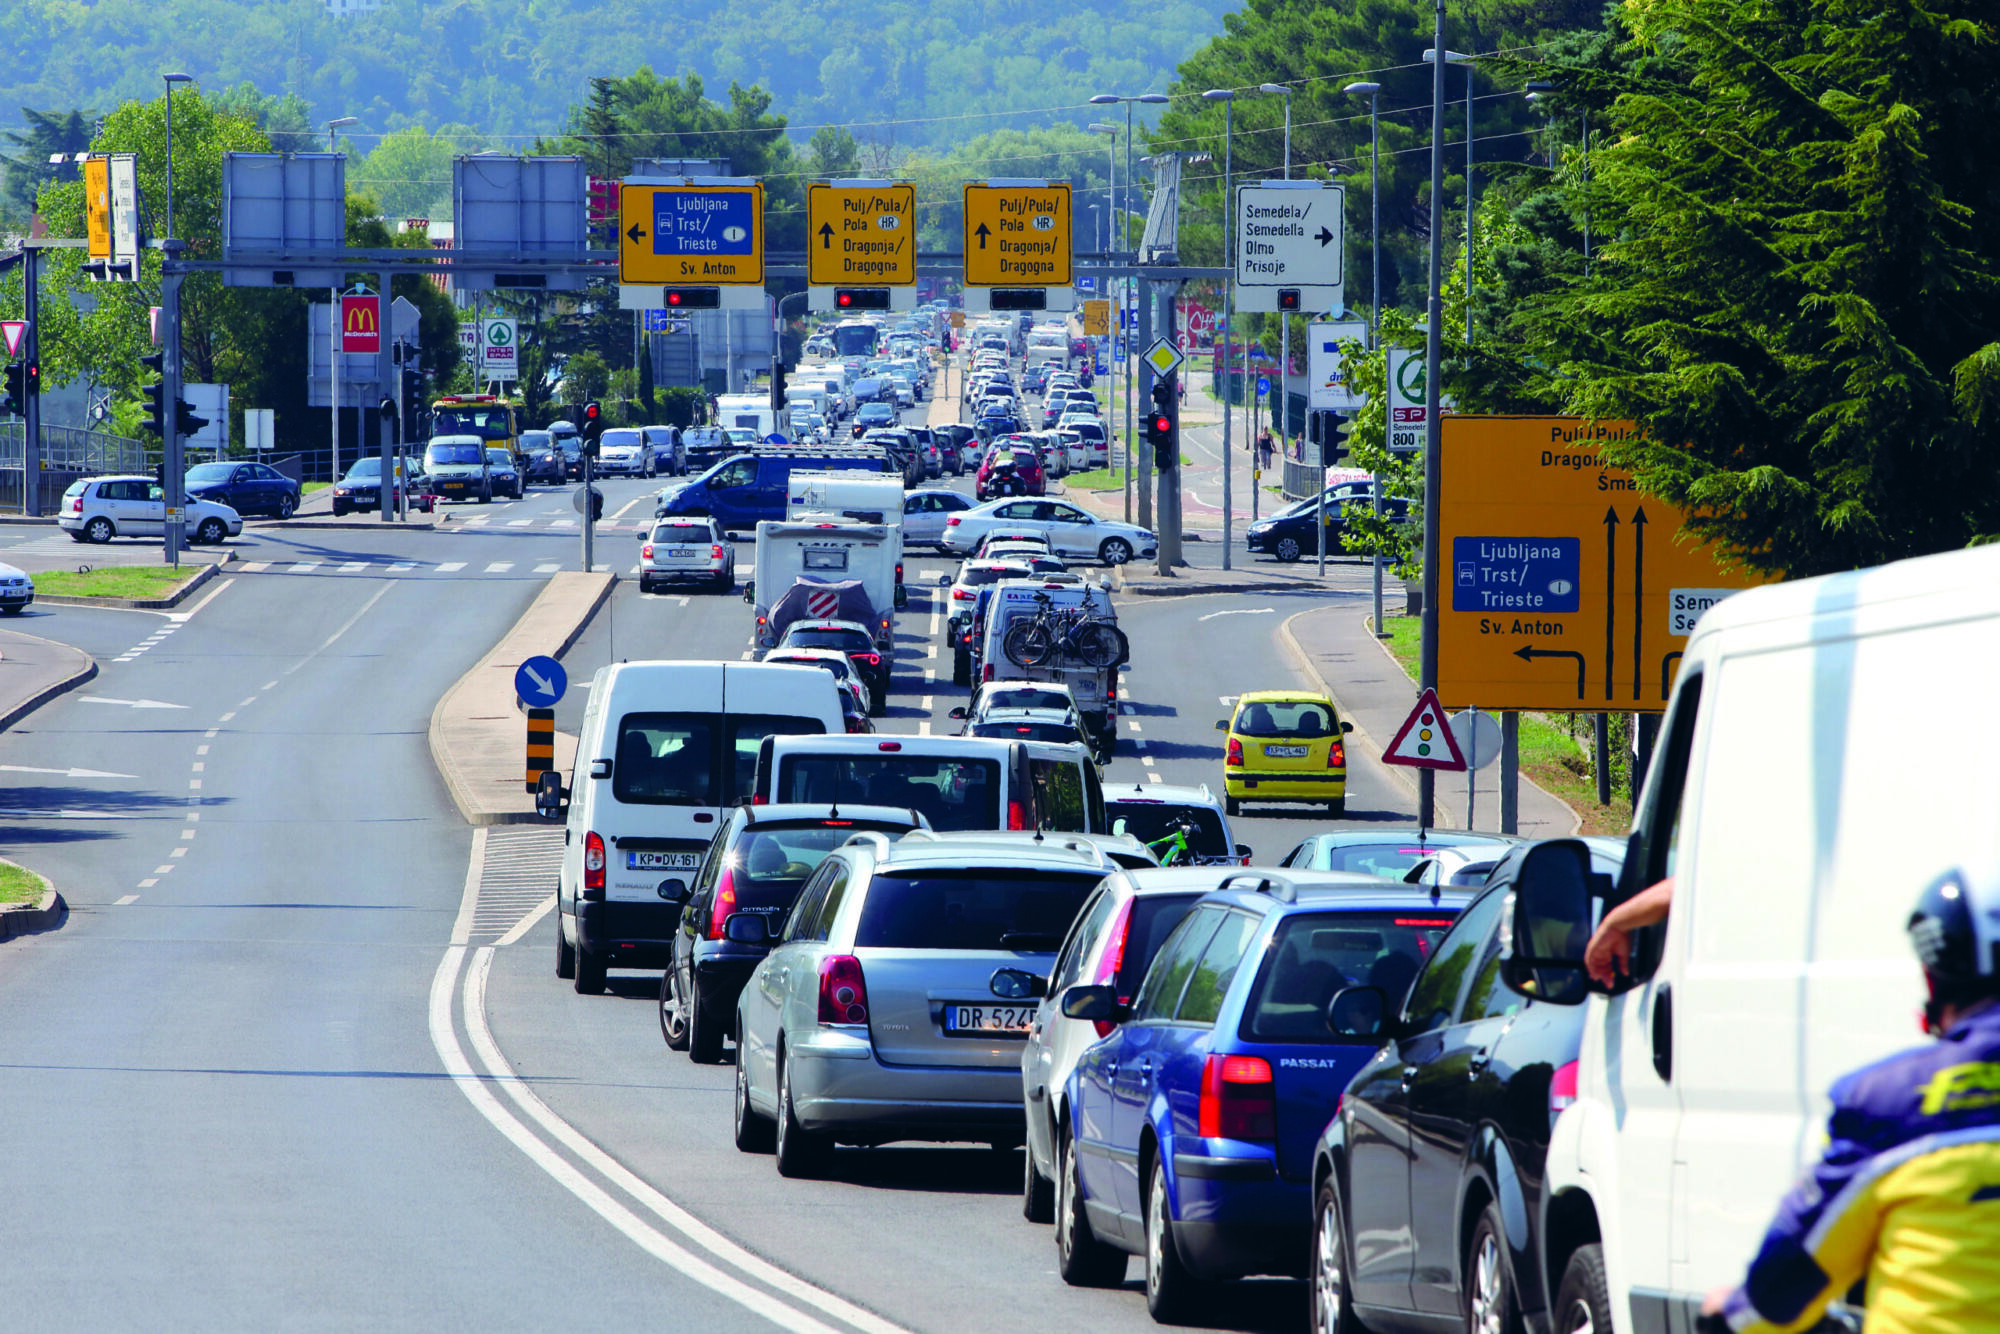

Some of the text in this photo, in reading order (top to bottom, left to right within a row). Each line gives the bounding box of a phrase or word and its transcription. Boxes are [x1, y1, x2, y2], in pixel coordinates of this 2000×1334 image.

[677, 197, 728, 213] Ljubljana
[843, 196, 910, 215] Pulj/Pula/
[1000, 196, 1059, 215] Pulj/Pula/
[1246, 202, 1312, 220] Semedela/
[677, 214, 711, 234] Trst/
[843, 217, 894, 231] Pola HR
[1000, 217, 1050, 231] Pola HR
[1246, 223, 1304, 236] Semedella
[677, 236, 718, 250] Trieste
[843, 236, 905, 255] Dragonja/
[1000, 236, 1058, 255] Dragonja/
[1246, 240, 1275, 254] Olmo
[680, 261, 736, 275] Sv. Anton
[843, 258, 898, 275] Dragogna
[1000, 258, 1055, 275] Dragogna
[1245, 259, 1286, 276] Prisoje
[1393, 433, 1415, 445] 800
[1481, 543, 1561, 562] Ljubljana
[1481, 564, 1528, 586] Trst/
[1481, 591, 1544, 607] Trieste
[1480, 619, 1564, 635] Sv. Anton
[640, 854, 654, 865] KP
[959, 1008, 983, 1028] DR
[1280, 1058, 1337, 1068] PASSAT
